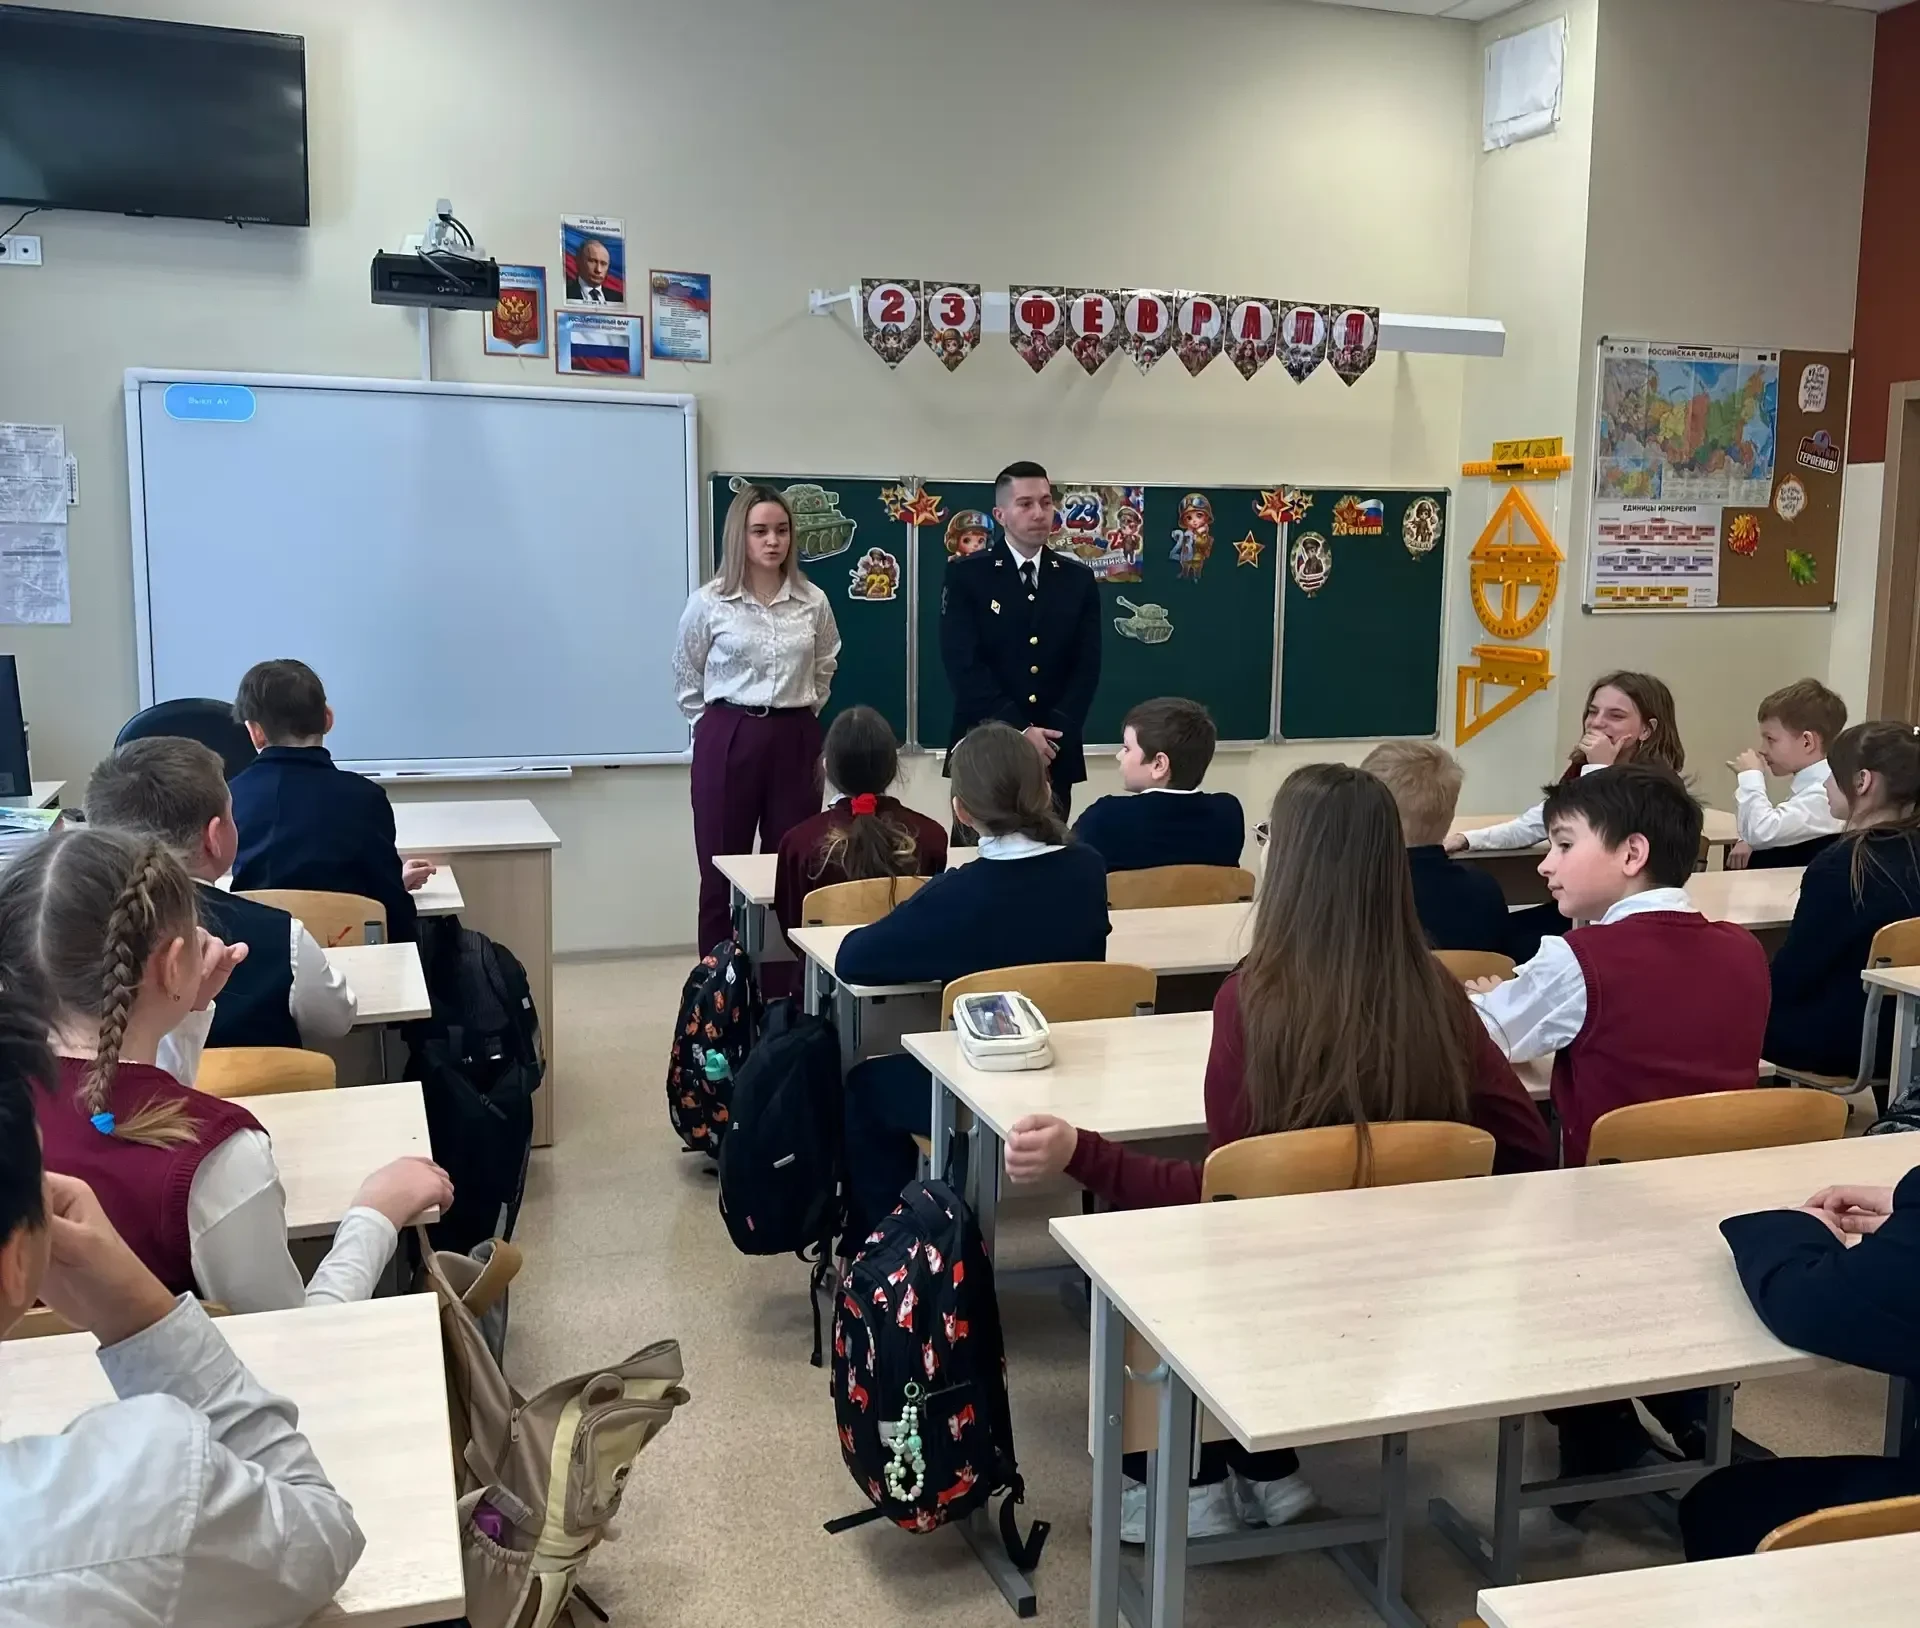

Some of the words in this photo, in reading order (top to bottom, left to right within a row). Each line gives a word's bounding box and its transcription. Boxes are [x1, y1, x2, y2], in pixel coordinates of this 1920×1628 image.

[880, 289, 966, 326] 23
[1021, 294, 1365, 346] ФЕВРАЛЯ
[1648, 347, 1697, 357] РОССИЙСКАЯ
[1699, 351, 1739, 360] ФЕДЕРАЦИЯ
[1065, 494, 1100, 530] 23
[1622, 504, 1656, 512] ЕДИНИЦЫ
[1332, 522, 1347, 536] 23
[1348, 526, 1382, 535] ФЕВРАЛЯ
[1169, 529, 1194, 561] 23
[867, 573, 889, 598] 23
